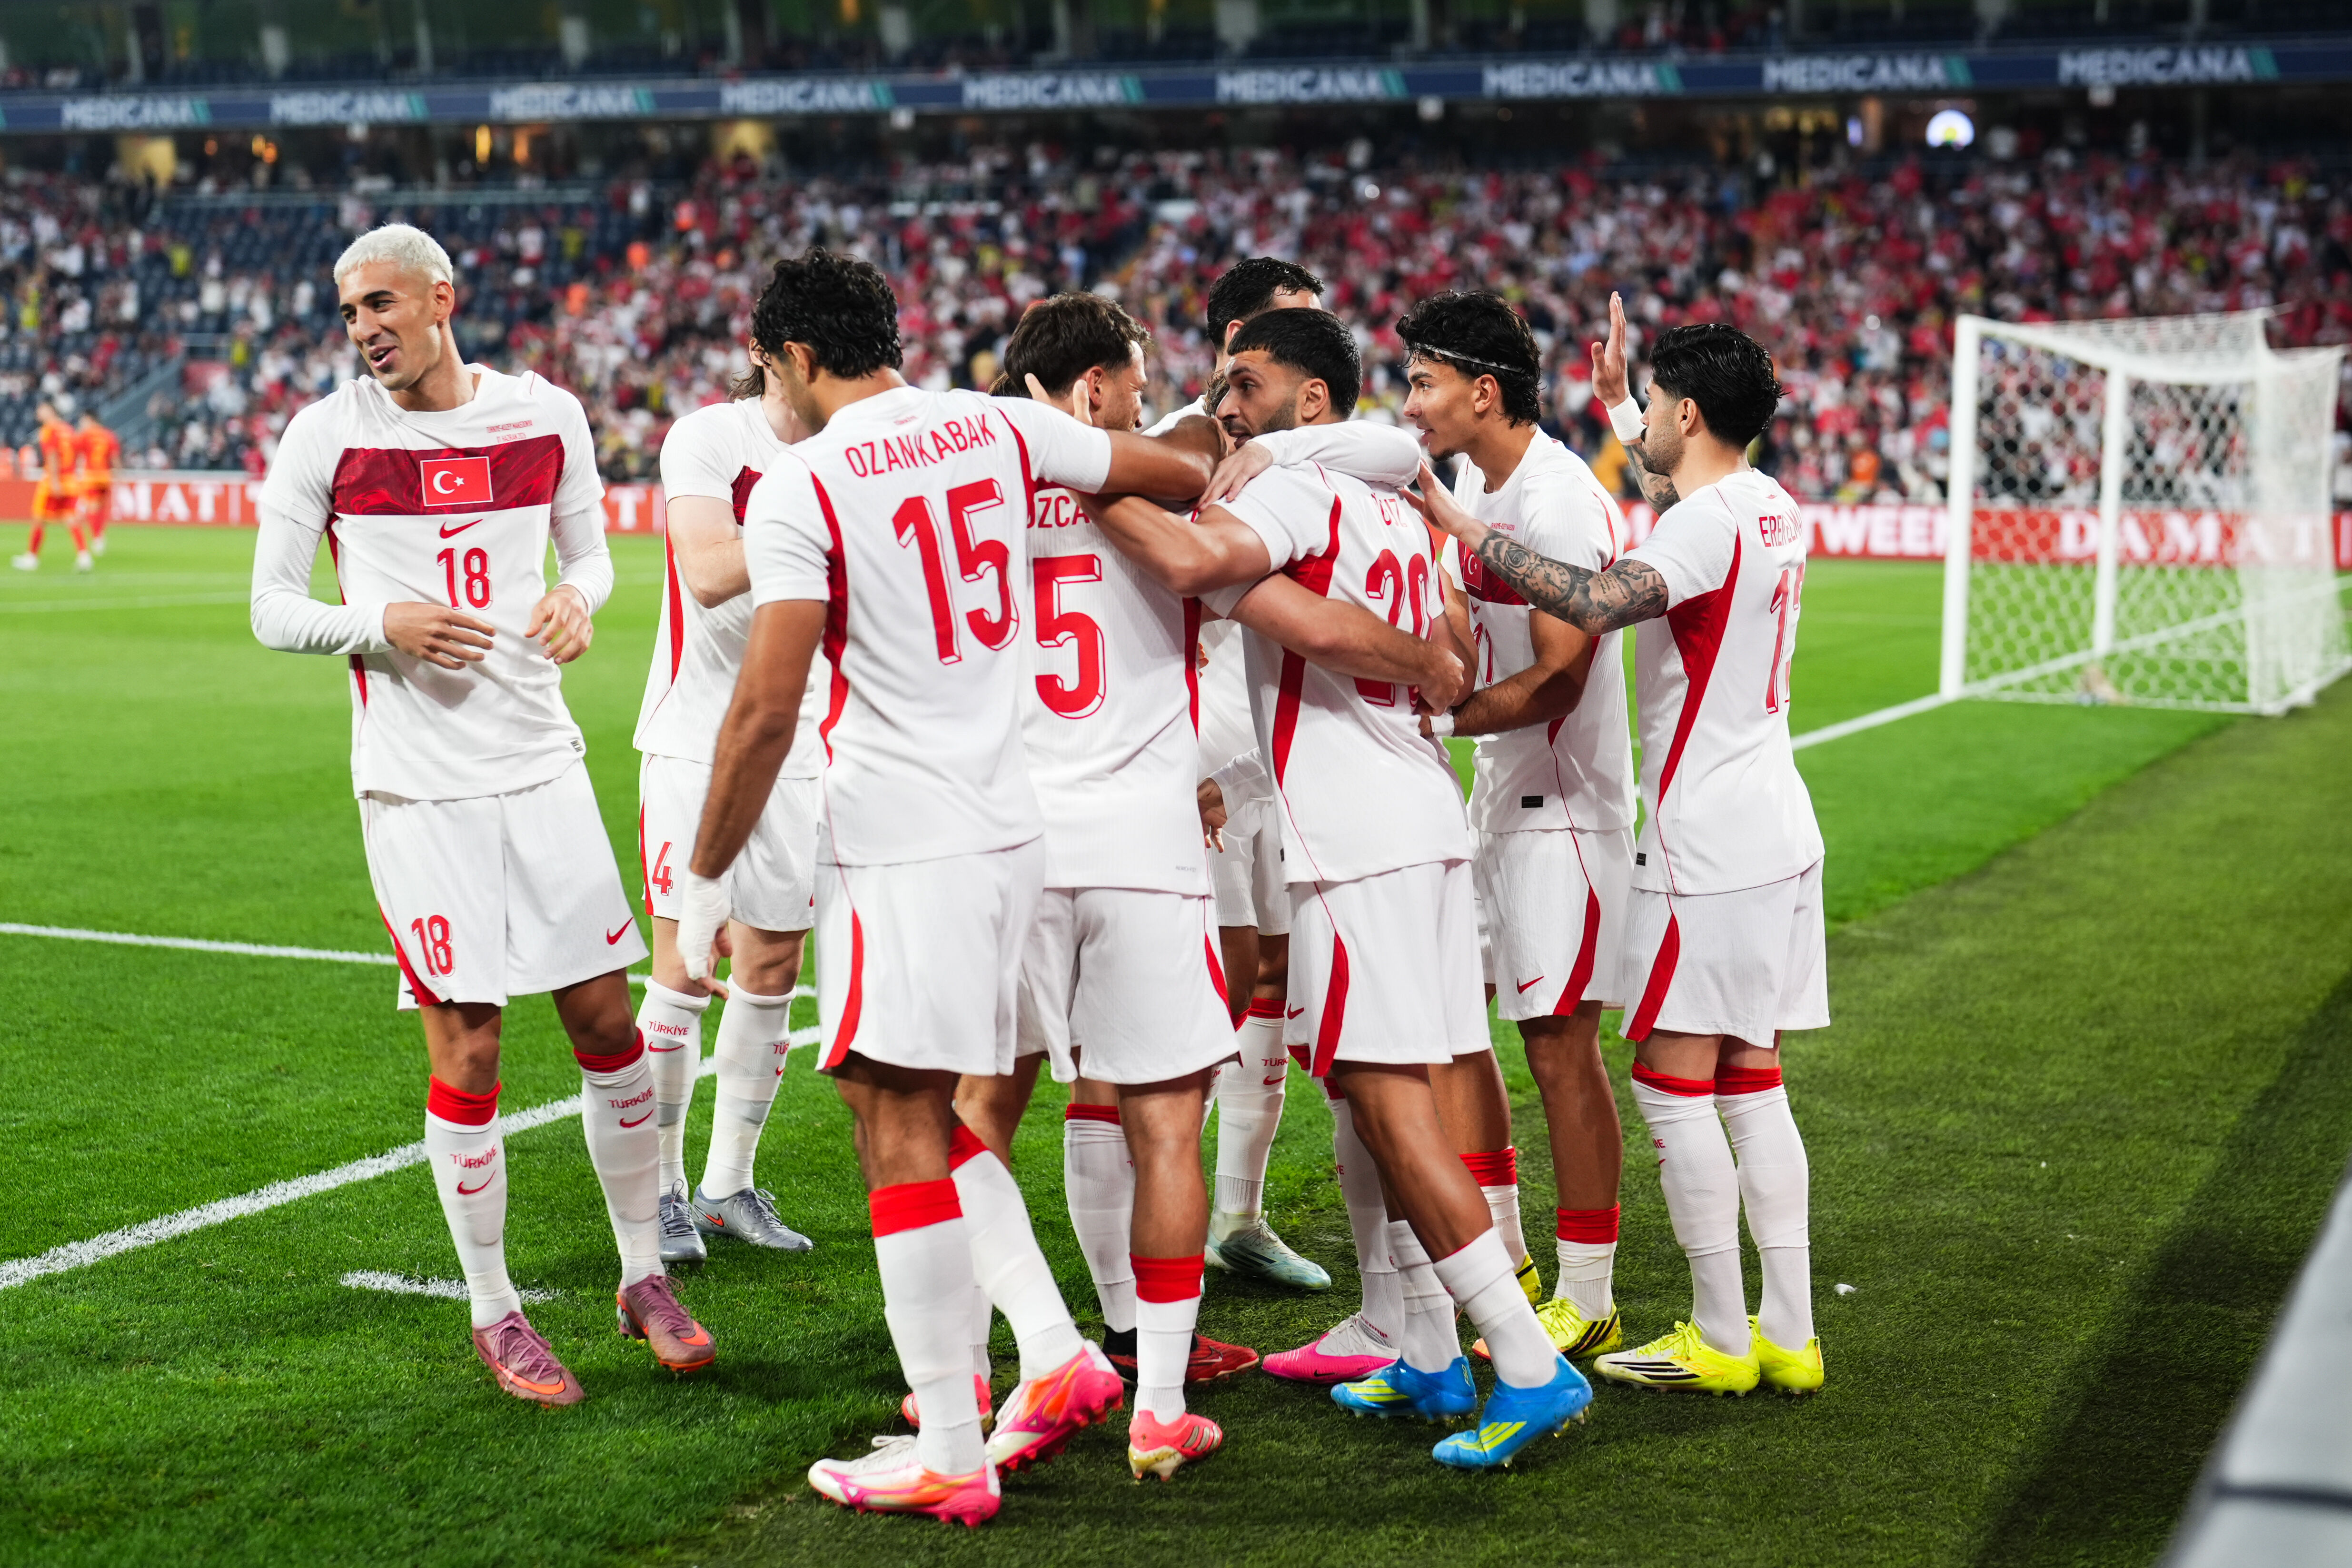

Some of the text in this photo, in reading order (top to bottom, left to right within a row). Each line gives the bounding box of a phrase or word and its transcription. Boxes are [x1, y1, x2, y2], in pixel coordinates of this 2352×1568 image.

[1482, 62, 1657, 95] MEDICANA
[1763, 57, 1948, 91] MEDICANA
[2058, 47, 2253, 85] MEDICANA
[721, 81, 873, 115] MEDICANA
[962, 75, 1124, 108] MEDICANA
[1216, 68, 1385, 103] MEDICANA
[60, 99, 196, 129] MEDICANA
[269, 93, 411, 124] MEDICANA
[489, 87, 635, 119] MEDICANA
[437, 547, 493, 611] 18
[892, 477, 1019, 665] 15
[1033, 554, 1106, 719] 5
[652, 841, 674, 896] 4
[411, 914, 456, 978] 18
[649, 1021, 689, 1036] TÜRKİYE
[608, 1086, 653, 1109] TÜRKİYE
[450, 1144, 497, 1169] TÜRKİYE
